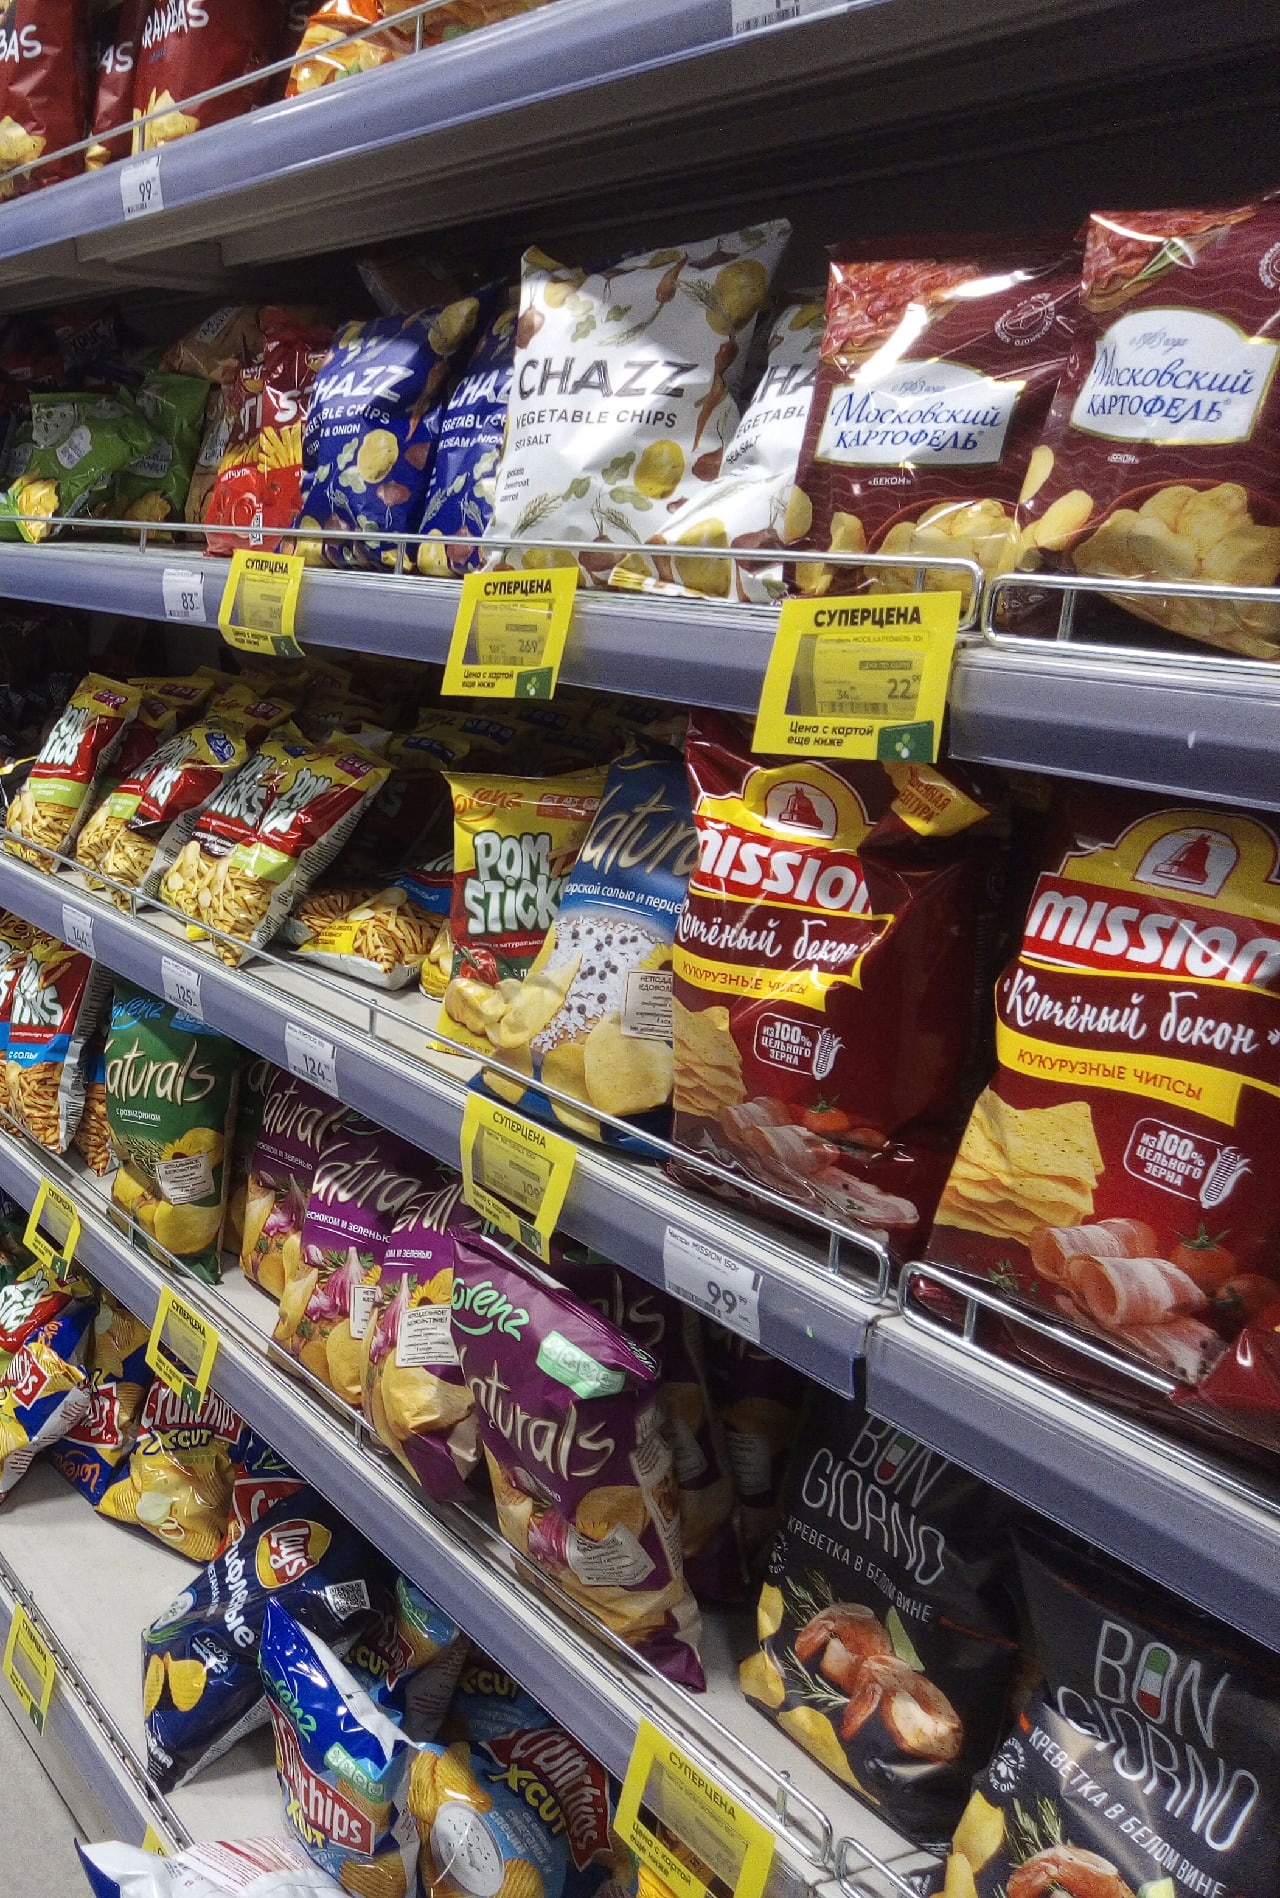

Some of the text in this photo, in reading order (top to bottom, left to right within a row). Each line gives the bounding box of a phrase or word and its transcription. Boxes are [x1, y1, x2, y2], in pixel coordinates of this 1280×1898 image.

[518, 356, 700, 400] CHAZZ
[1093, 341, 1255, 395] Московский
[515, 408, 678, 430] VEGETABLE CHIPS
[831, 390, 1003, 428] Московский
[1087, 393, 1224, 424] КАРТОФЕЛЬ
[835, 429, 982, 453] КАРТОФЕЛЬ
[245, 558, 289, 575] СУПЕРЦЕНА
[483, 579, 552, 597] СУПЕРЦЕНА
[814, 606, 922, 629] СУПЕРЦЕНА
[887, 678, 912, 700] 22
[787, 736, 844, 748] еще ниже
[789, 721, 819, 735] Цена
[831, 724, 875, 737] картой
[472, 830, 553, 881] POM
[565, 881, 600, 897] орской
[601, 887, 636, 903] солью
[645, 895, 682, 914] перце
[682, 961, 763, 991] КУКУРУЗНЫЕ
[761, 1036, 812, 1059] ЦЕЛЬНОГО
[774, 1020, 813, 1048] 100%
[105, 1038, 216, 1106] aturals
[769, 1049, 800, 1067] ЗЕРНА
[1017, 1049, 1204, 1101] КУКУРУЗНЫЕ ЧИПСЫ
[492, 1111, 547, 1149] СУПЕРЦЕНА
[1157, 1129, 1206, 1168] 100%
[1135, 1144, 1204, 1180] ЦЕЛЬНОГО
[1143, 1163, 1184, 1188] ЗЕРНА
[707, 1280, 738, 1314] 99
[847, 1416, 952, 1508] BON
[802, 1447, 946, 1586] GIORNO
[270, 1526, 309, 1577] Lay's
[786, 1515, 851, 1565] КРЕВЕТКА
[896, 1591, 934, 1624] ВИНЕ
[1094, 1619, 1232, 1750] BON
[669, 1751, 737, 1822] СУПЕРЦЕНА
[1057, 1686, 1260, 1851] GIORNO
[487, 1763, 568, 1835] X-CUT
[1027, 1726, 1109, 1810] КРЕВЕТКА
[1120, 1814, 1182, 1873] БЕЛОМ
[1176, 1858, 1227, 1898] ВИНЕ
[632, 1821, 653, 1849] Цена
[661, 1851, 692, 1887] картой
